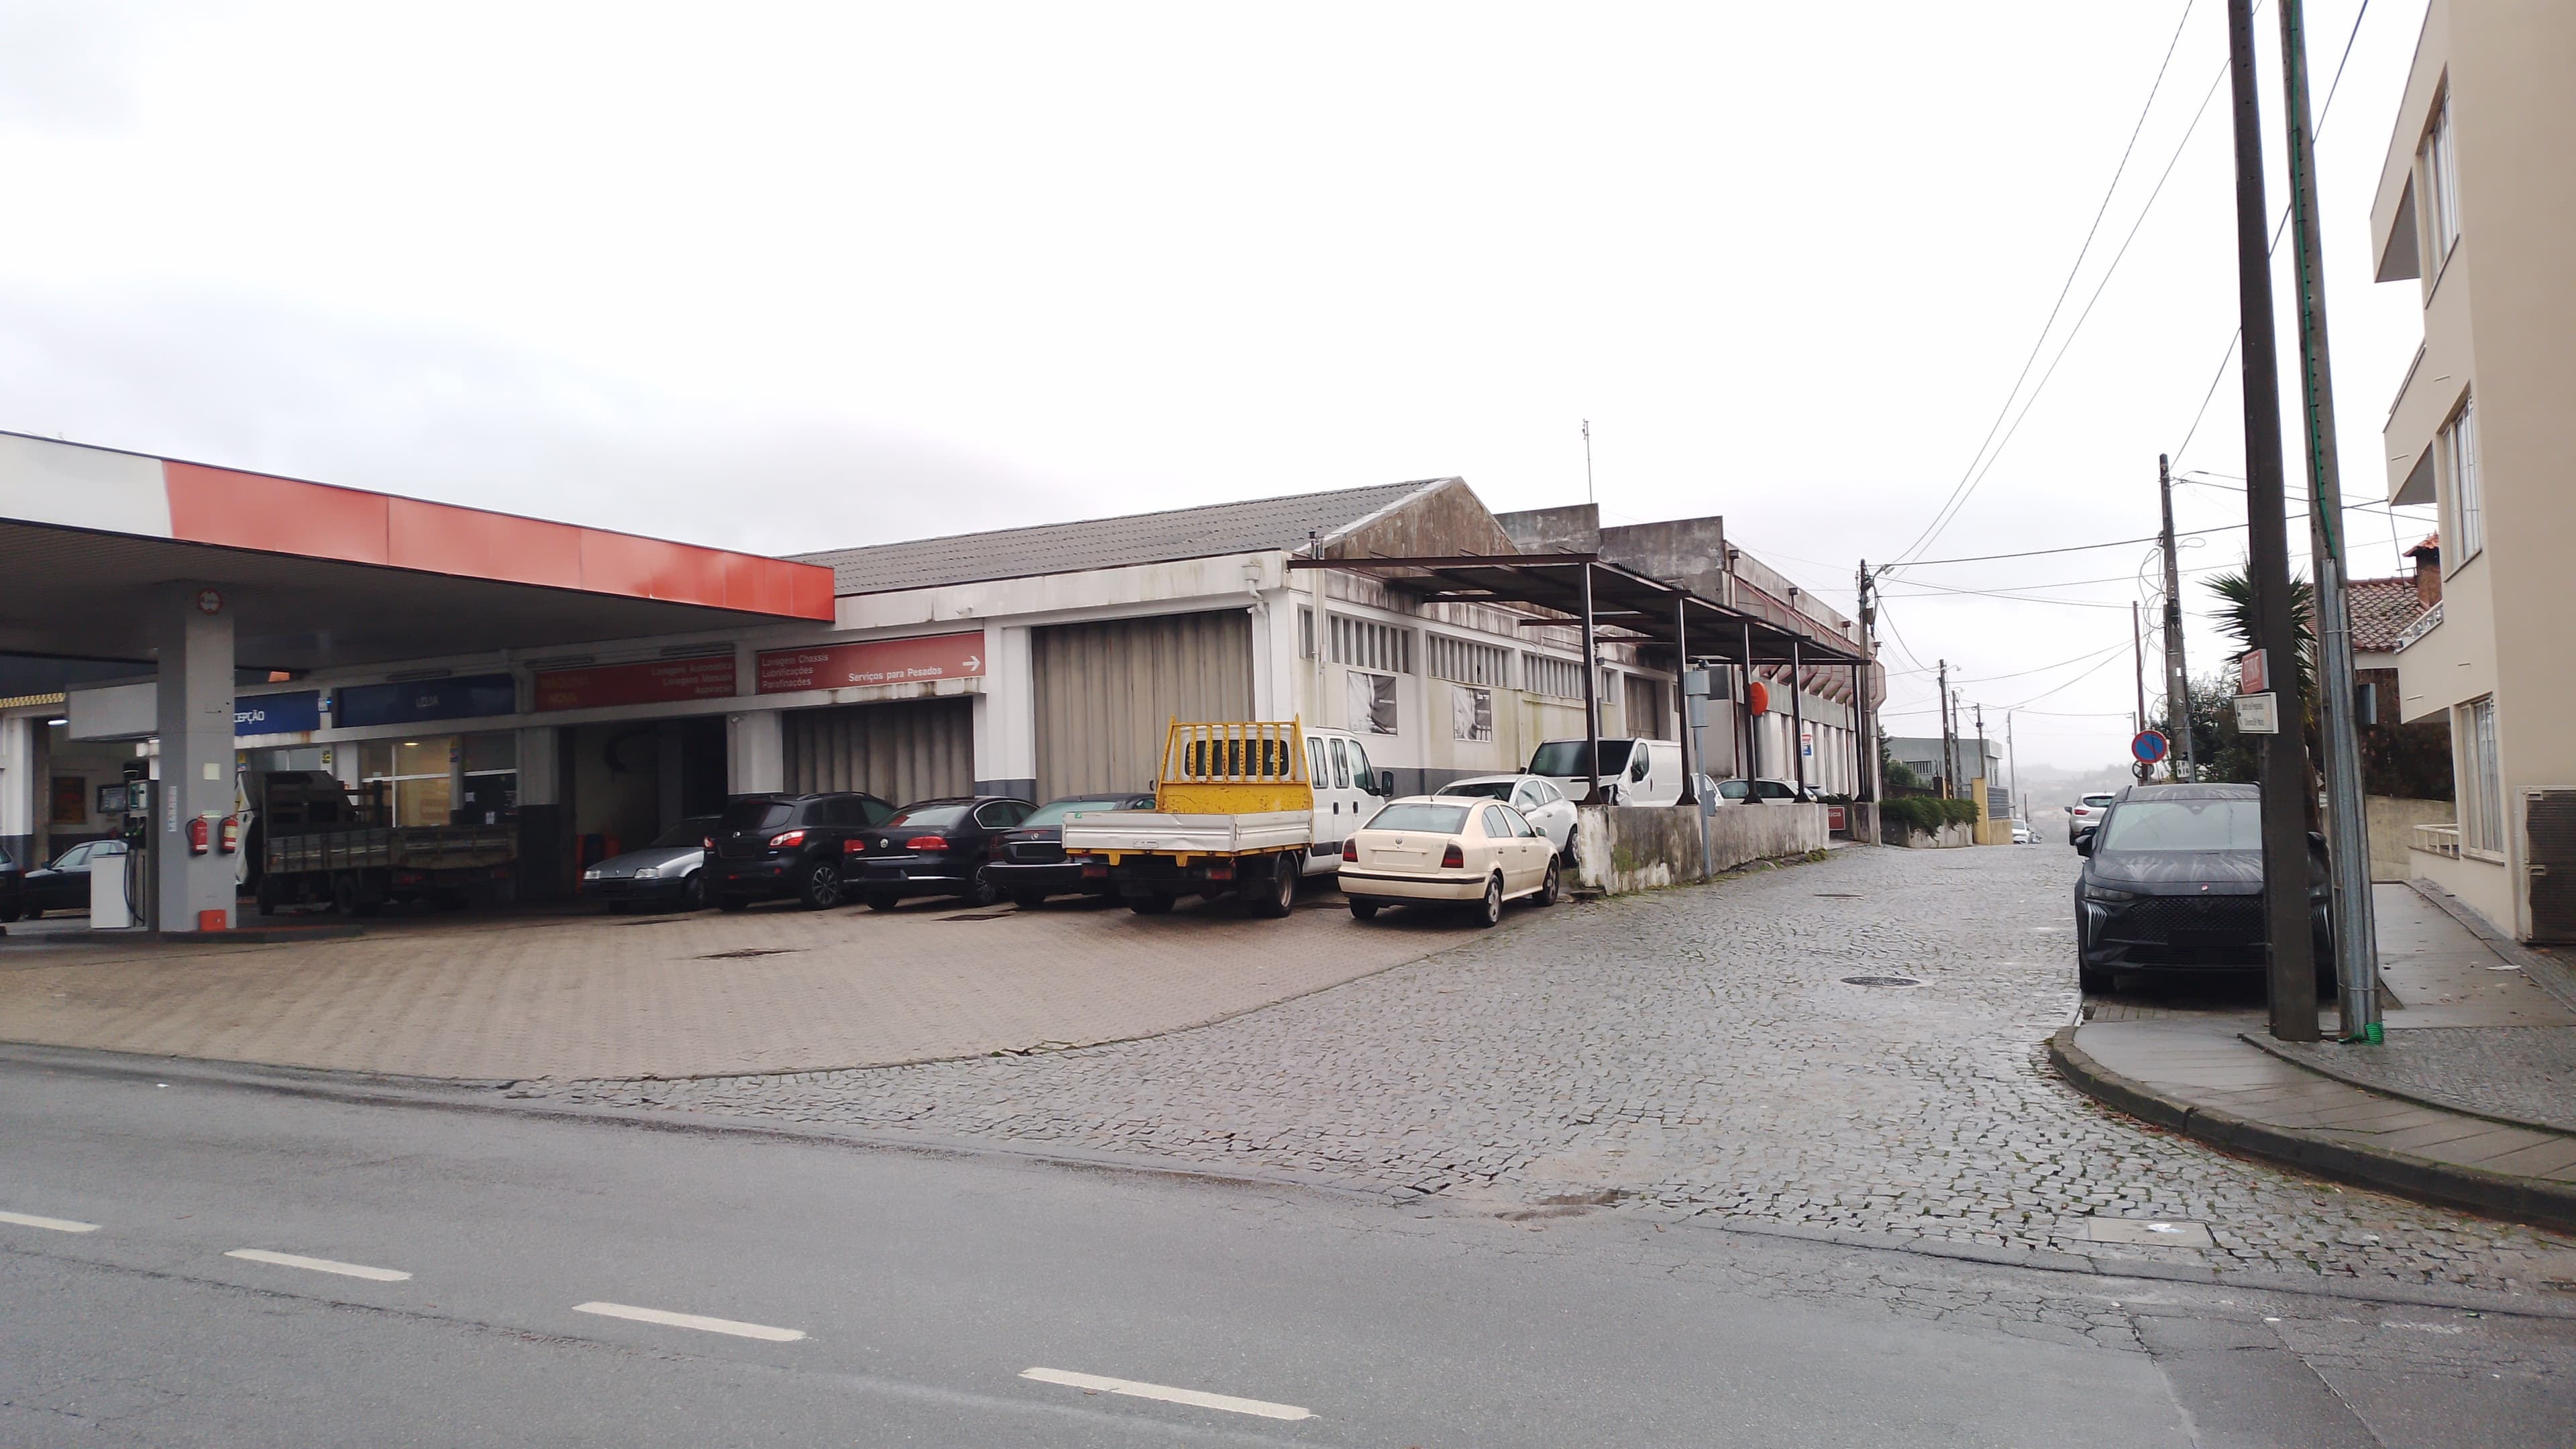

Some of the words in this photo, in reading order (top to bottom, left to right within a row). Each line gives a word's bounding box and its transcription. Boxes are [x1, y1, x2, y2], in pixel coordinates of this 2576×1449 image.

[762, 657, 796, 667] Lavagem
[798, 653, 828, 663] Chassis
[762, 666, 814, 678] Lubrificações
[848, 672, 883, 683] Serviços
[886, 670, 904, 680] para
[907, 665, 943, 678] Pesados
[762, 677, 811, 689] Parafinações
